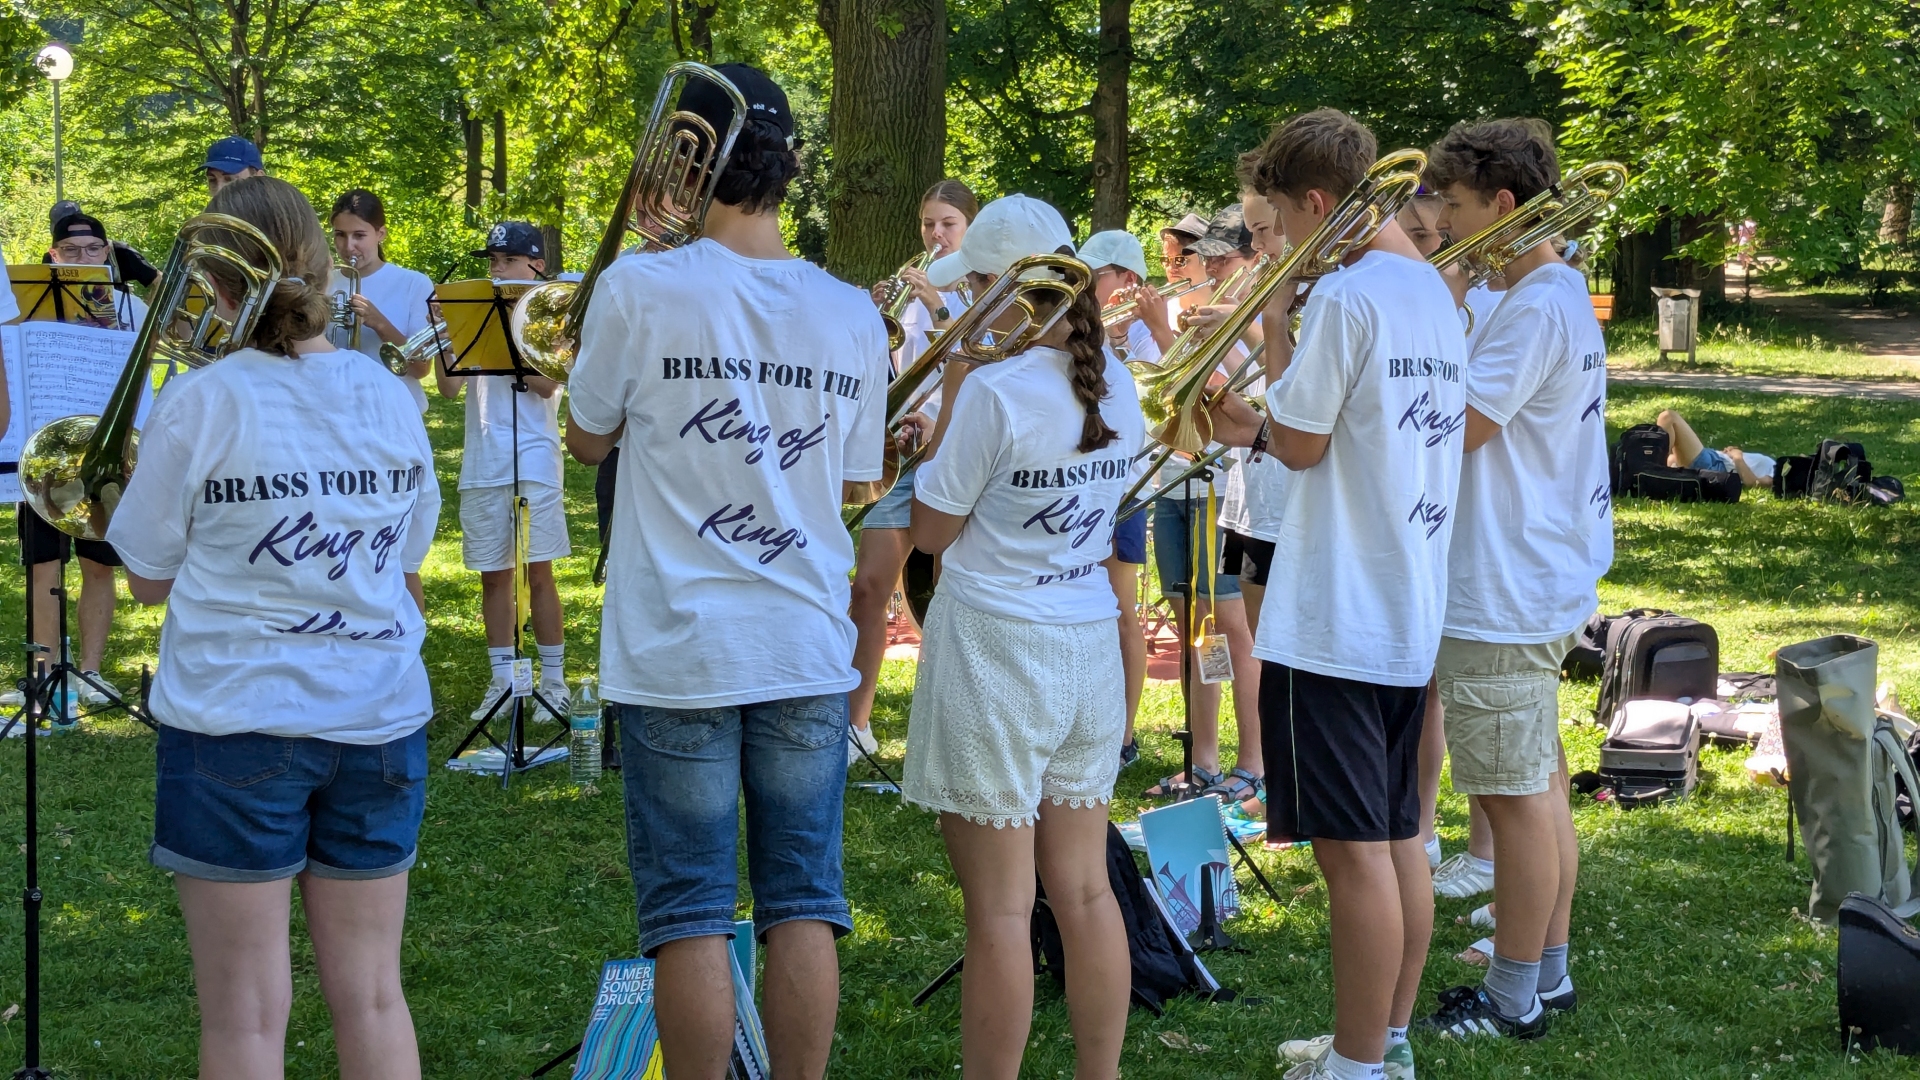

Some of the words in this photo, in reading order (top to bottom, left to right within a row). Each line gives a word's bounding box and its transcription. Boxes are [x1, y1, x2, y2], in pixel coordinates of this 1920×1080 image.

[662, 357, 752, 381] BRASS
[757, 362, 813, 390] FOR
[679, 397, 771, 465] King
[777, 413, 831, 471] of
[203, 470, 309, 504] BRASS
[318, 469, 378, 496] FOR
[1011, 463, 1088, 489] BRASS
[248, 511, 365, 581] King
[370, 499, 415, 574] of
[697, 503, 808, 565] Kings
[601, 978, 654, 994] SONDER
[605, 966, 651, 981] ULMER
[598, 991, 646, 1006] DRUCK
